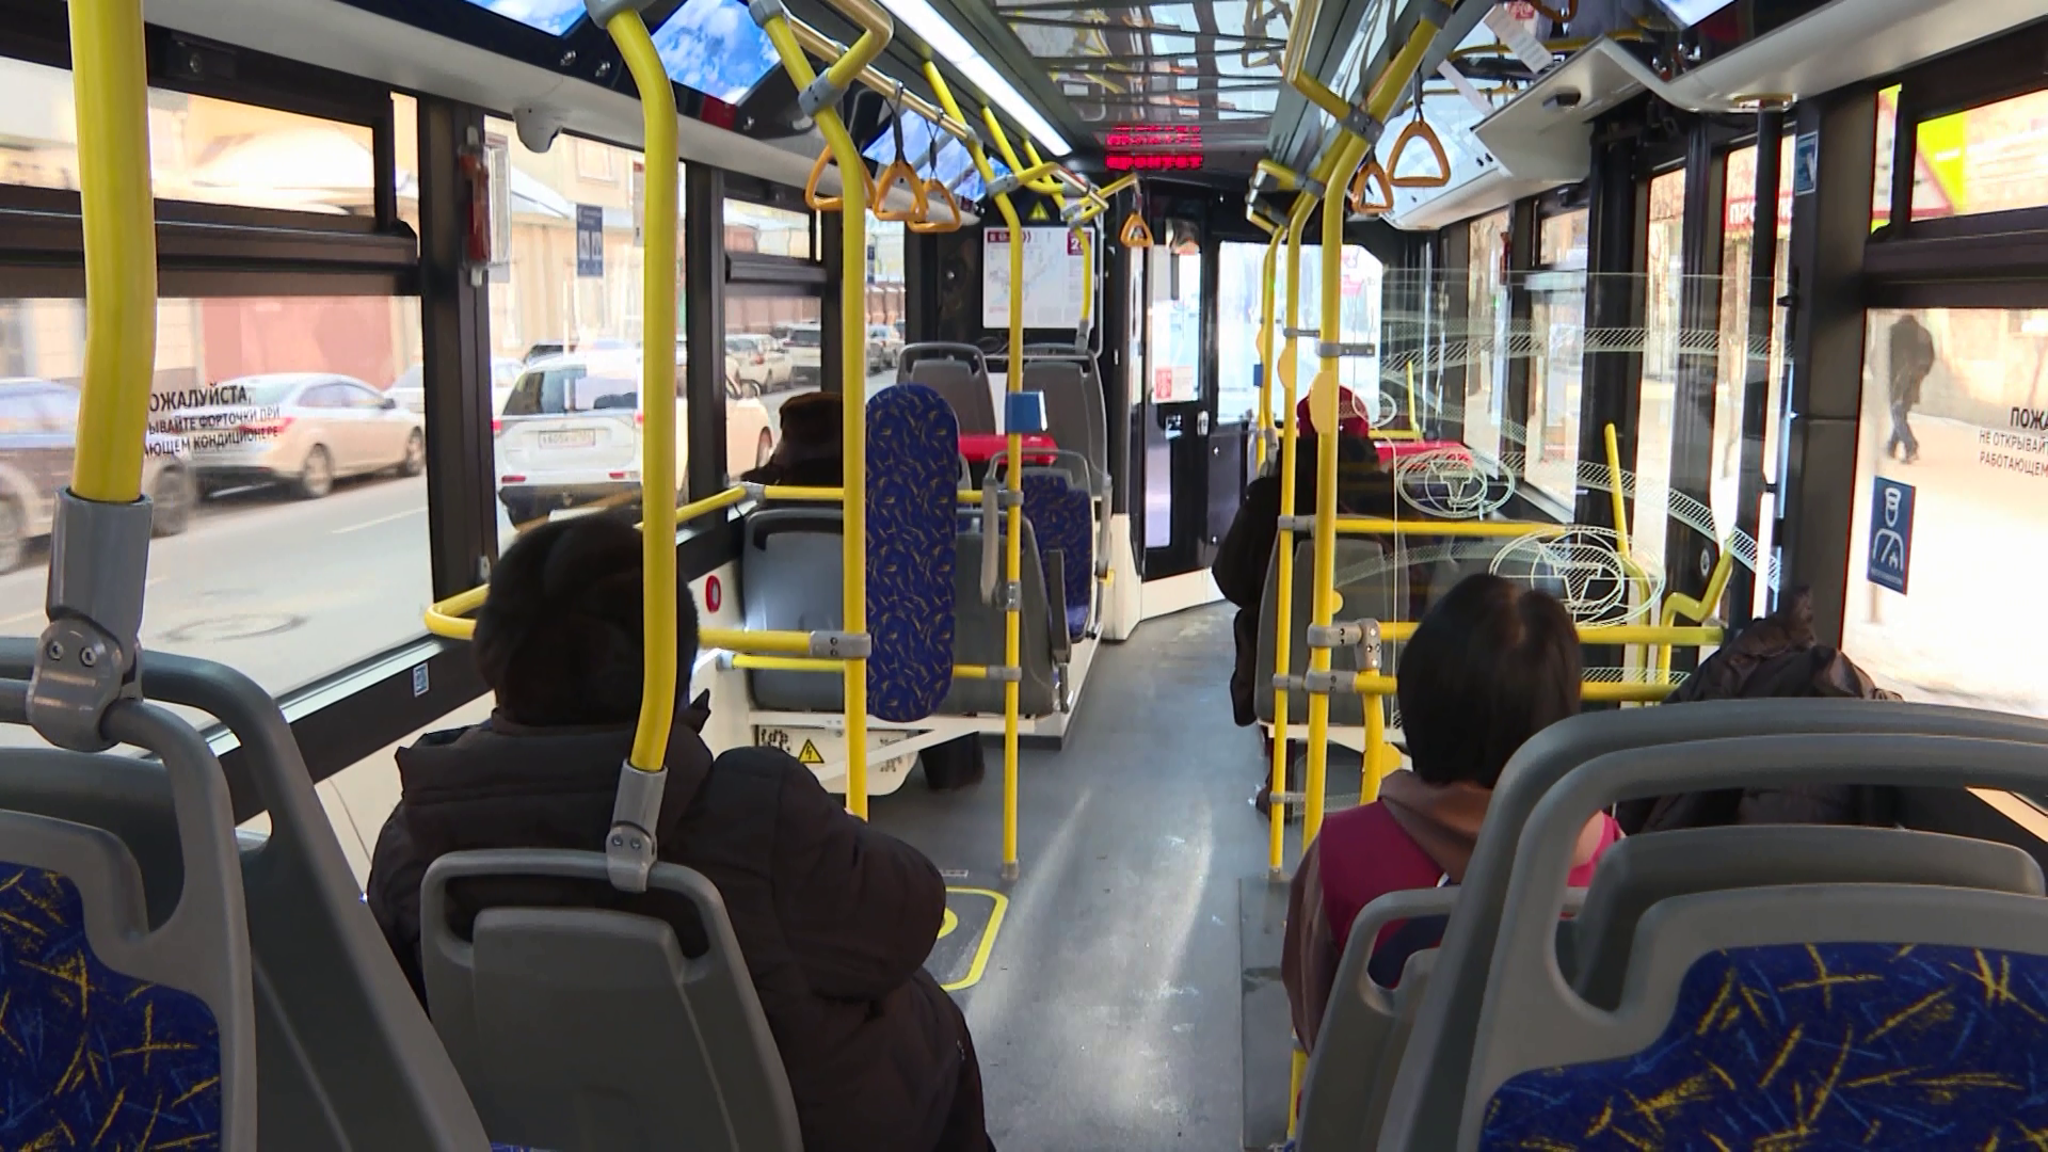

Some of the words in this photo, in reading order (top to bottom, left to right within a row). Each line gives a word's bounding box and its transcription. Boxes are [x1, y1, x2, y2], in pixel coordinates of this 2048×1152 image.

[149, 382, 252, 412] ОЖАЛУЙСТА,
[149, 415, 196, 435] ЫВАЙТЕ
[199, 407, 257, 427] ФОРТОЧКИ
[260, 402, 281, 422] ПРИ
[193, 426, 279, 451] КОНДИЦИОНЕРЕ
[1979, 430, 1991, 444] НЕ
